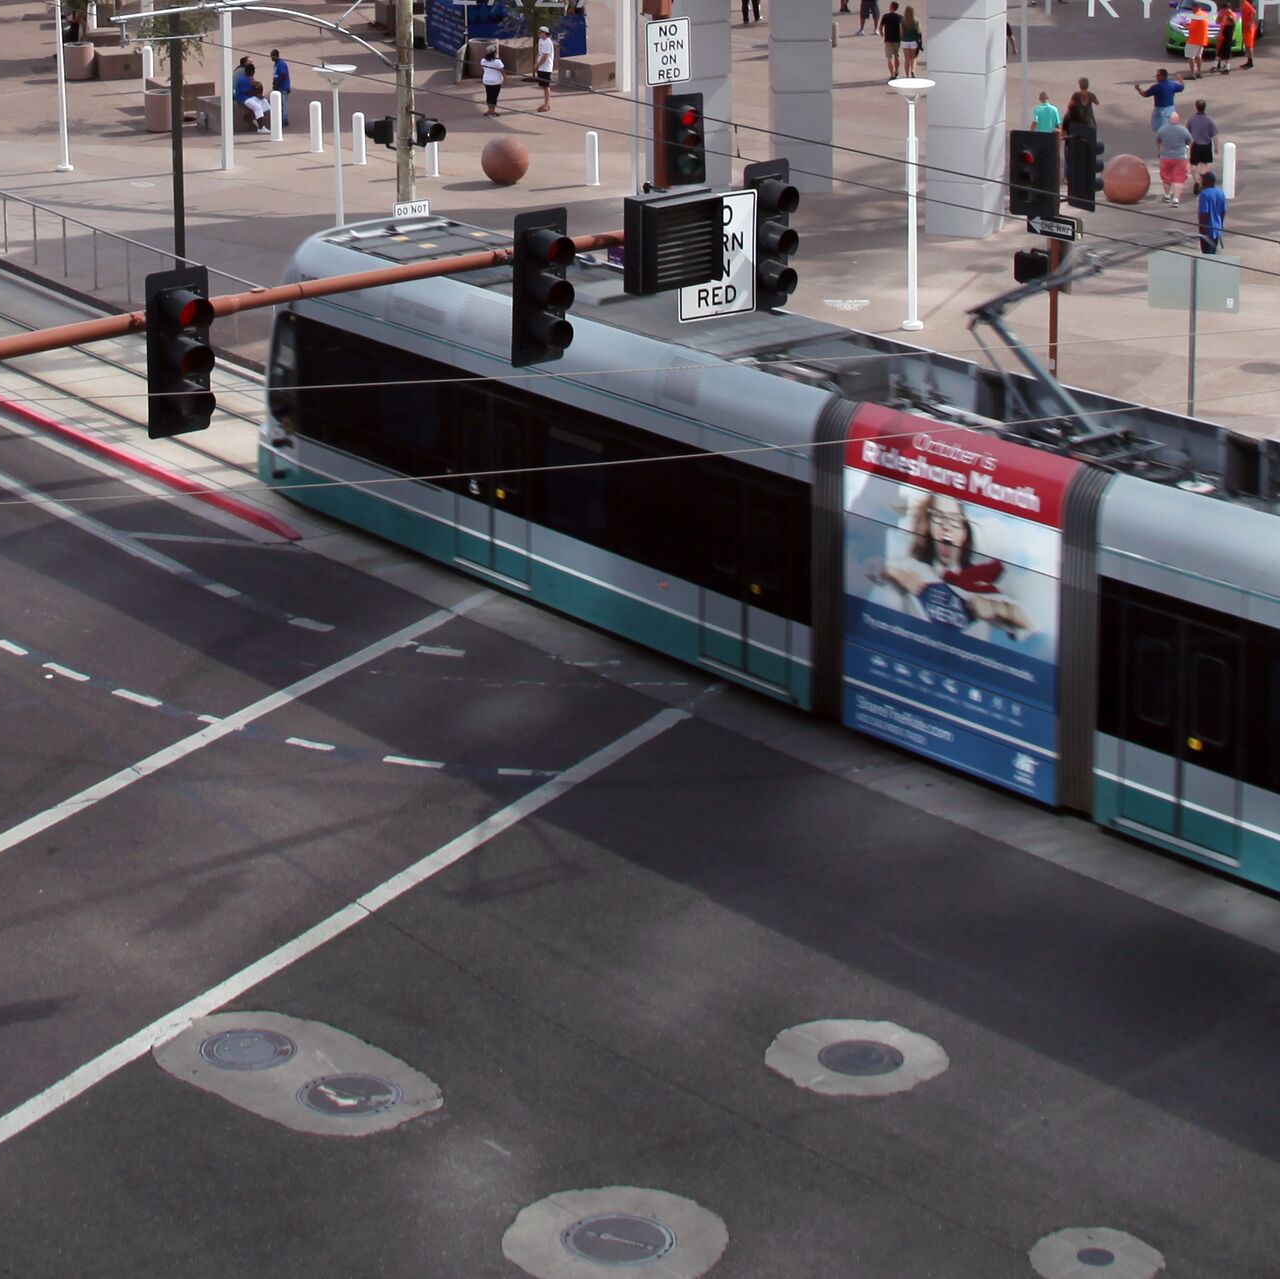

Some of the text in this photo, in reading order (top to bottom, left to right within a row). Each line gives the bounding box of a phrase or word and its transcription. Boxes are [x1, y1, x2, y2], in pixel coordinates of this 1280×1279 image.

[659, 24, 678, 37] NO
[654, 39, 684, 53] TURN
[661, 54, 677, 66] ON
[658, 69, 681, 80] RED
[397, 204, 427, 216] DO NOT
[698, 285, 736, 308] RED
[912, 431, 982, 465] October
[862, 439, 1041, 513] Rideshare Month
